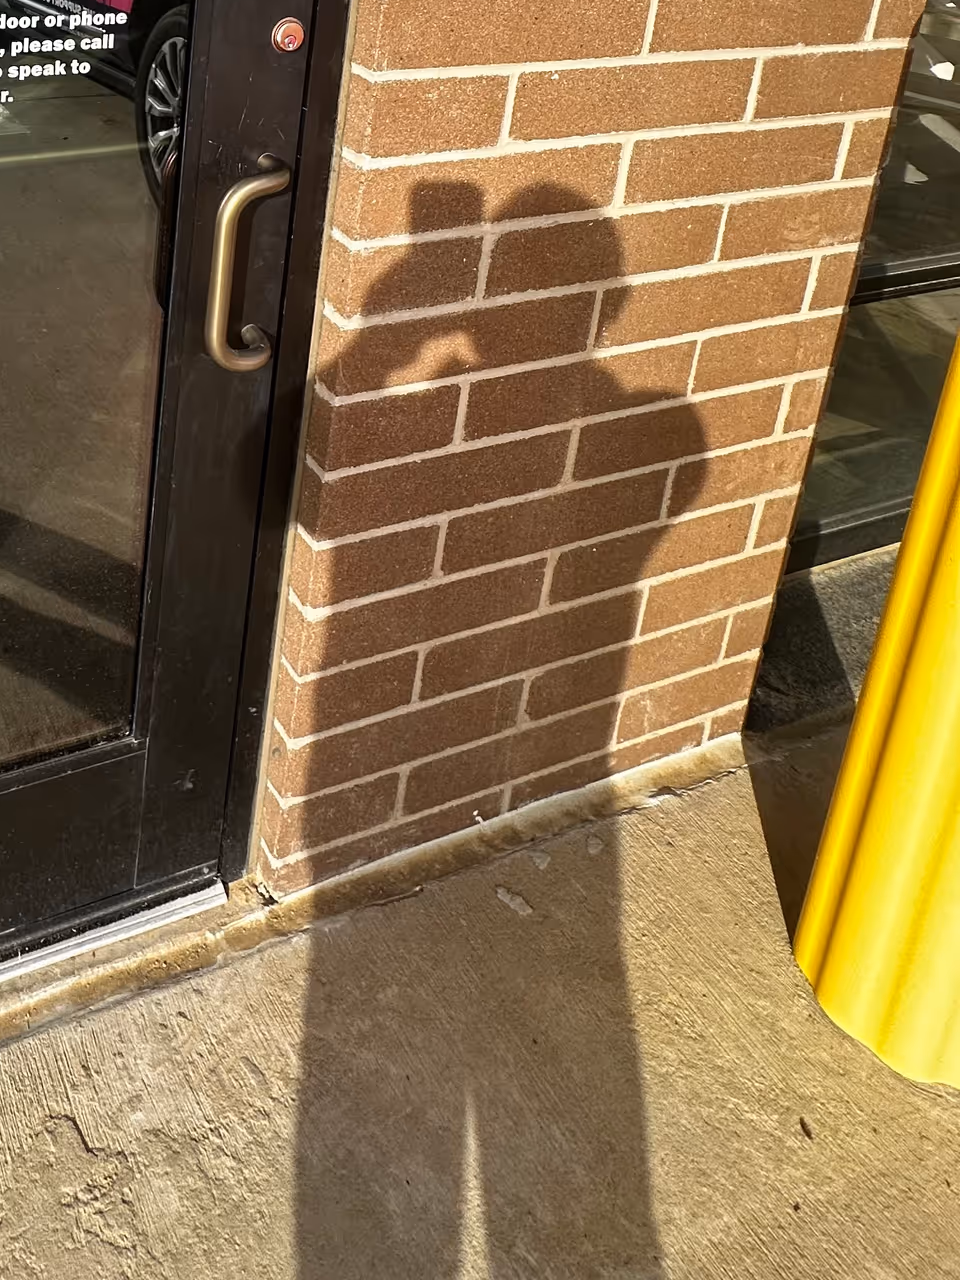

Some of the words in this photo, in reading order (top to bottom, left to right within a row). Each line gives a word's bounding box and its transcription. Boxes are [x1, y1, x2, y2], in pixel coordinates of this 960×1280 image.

[44, 14, 65, 27] or
[69, 11, 128, 29] phone
[11, 36, 76, 57] please
[80, 34, 115, 50] call
[7, 60, 67, 81] speak
[71, 59, 91, 75] to
